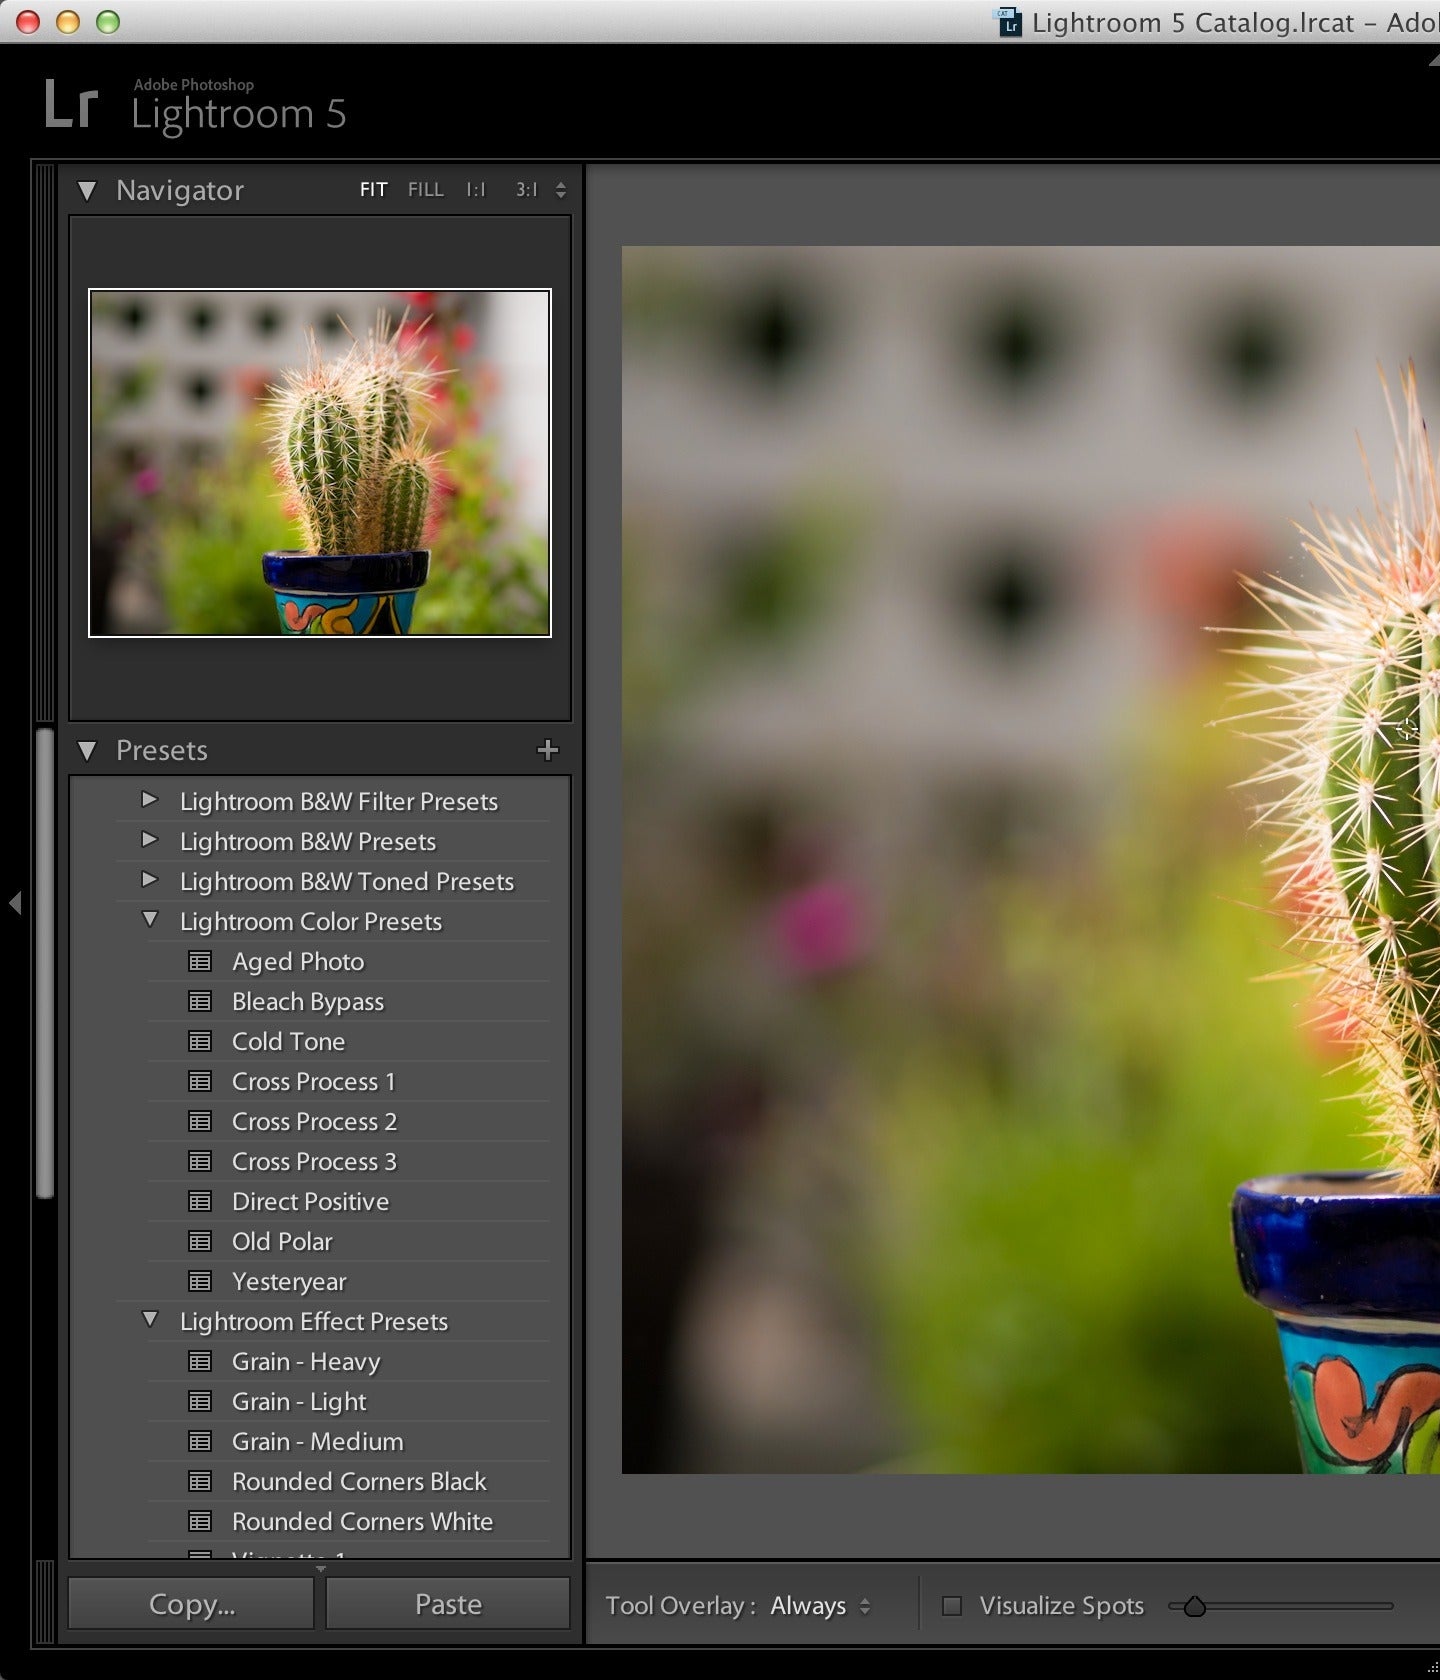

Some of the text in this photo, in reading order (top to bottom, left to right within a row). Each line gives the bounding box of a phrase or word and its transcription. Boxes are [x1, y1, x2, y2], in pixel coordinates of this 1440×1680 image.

[1006, 20, 1018, 32] Lr
[1033, 11, 1161, 38] Lightroom
[1172, 12, 1185, 34] 5
[1195, 11, 1355, 38] Catalog.lrcat
[133, 77, 255, 95] Adobe Photoshop
[45, 78, 99, 128] Lr
[133, 95, 346, 140] Lightroom 5
[117, 178, 245, 207] Navigator
[360, 181, 444, 197] FIT FILL
[467, 181, 485, 197] 1:1
[516, 181, 537, 197] 3:1
[117, 738, 208, 761] Presets
[181, 790, 499, 816] Lightroom B&W Filter Presets
[181, 830, 437, 856] Lightroom B&W Presets
[181, 870, 515, 896] Lightroom B&W Toned Presets
[181, 910, 443, 936] Lightroom Color Presets
[232, 950, 365, 976] Aged Photo
[233, 990, 385, 1016] Bleach Bypass
[232, 1030, 346, 1051] Cold Tone
[232, 1071, 394, 1091] Cross Process 1
[232, 1111, 398, 1131] Cross Process 2
[232, 1151, 397, 1171] Cross Process 3
[233, 1191, 390, 1211] Direct Positive
[232, 1230, 334, 1251] Old Polar
[232, 1271, 348, 1297] Yesteryear
[181, 1310, 449, 1336] Lightroom Effect Presets
[232, 1351, 290, 1371] Grain
[311, 1351, 381, 1377] Heavy
[232, 1391, 290, 1411] Grain
[311, 1390, 367, 1416] Light
[232, 1431, 290, 1451] Grain
[310, 1430, 404, 1451] Medium
[233, 1470, 488, 1491] Rounded Corners Black
[233, 1510, 494, 1531] Rounded Corners White
[149, 1592, 235, 1621] Copy...
[416, 1592, 482, 1615] Paste
[605, 1594, 653, 1615] Tool
[770, 1594, 847, 1621] Always
[979, 1594, 1144, 1620] Visualize Spots
